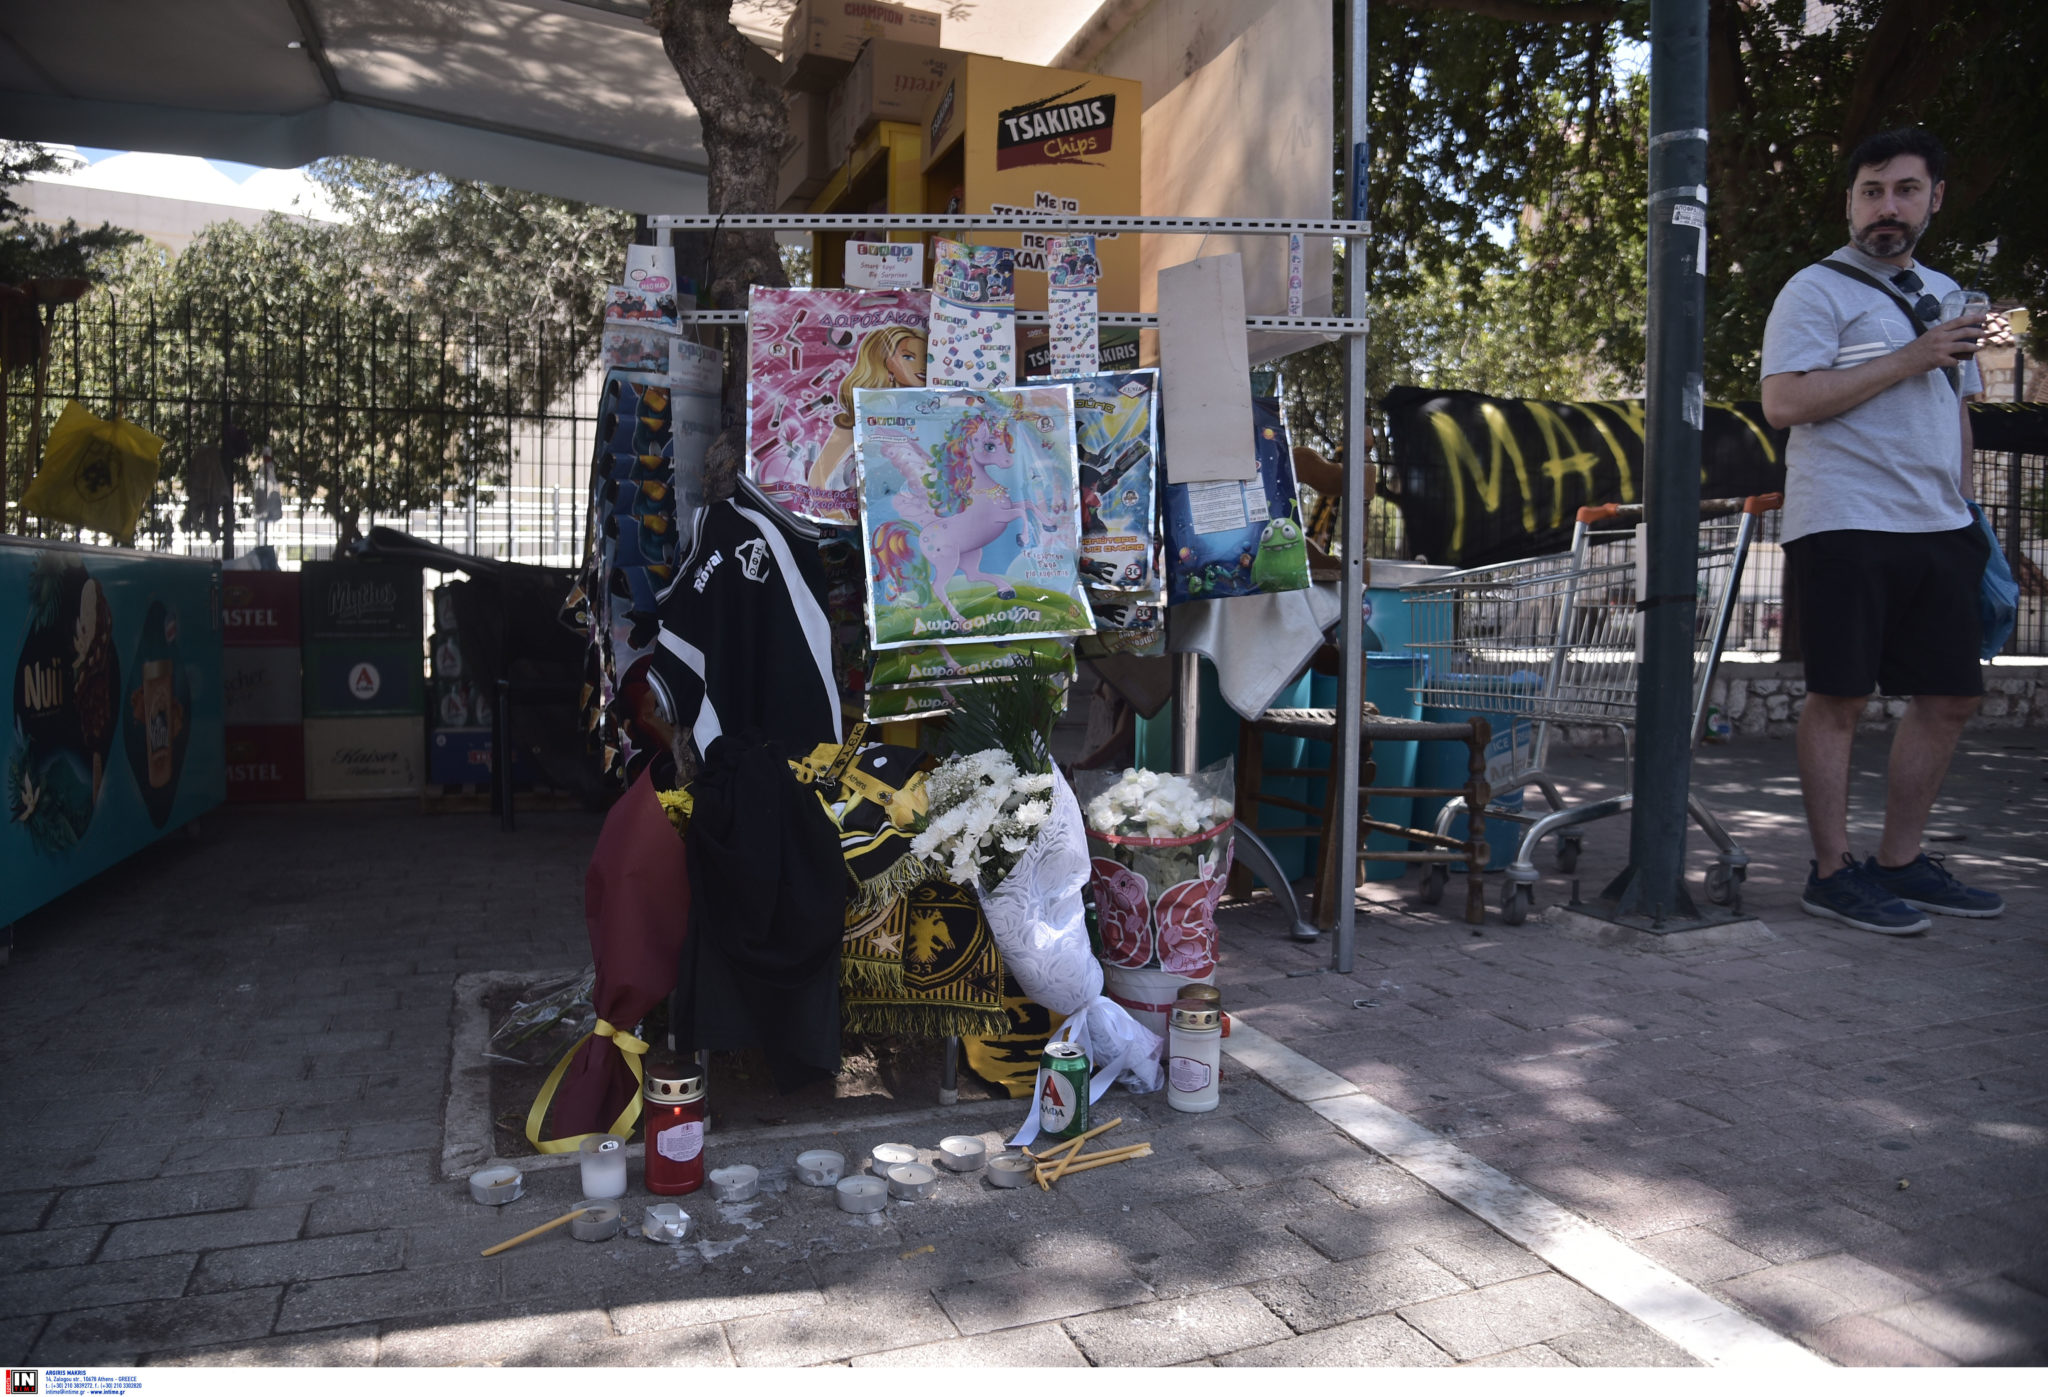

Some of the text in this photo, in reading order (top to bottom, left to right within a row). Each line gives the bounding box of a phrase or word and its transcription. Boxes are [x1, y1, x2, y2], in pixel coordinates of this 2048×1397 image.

[844, 3, 904, 26] CHAMPION
[1004, 101, 1106, 142] TSAKIRIS
[1044, 135, 1097, 158] Chips
[1036, 193, 1057, 210] Με
[1062, 197, 1077, 211] τα
[693, 549, 724, 594] Royal
[1493, 736, 1510, 752] ICE
